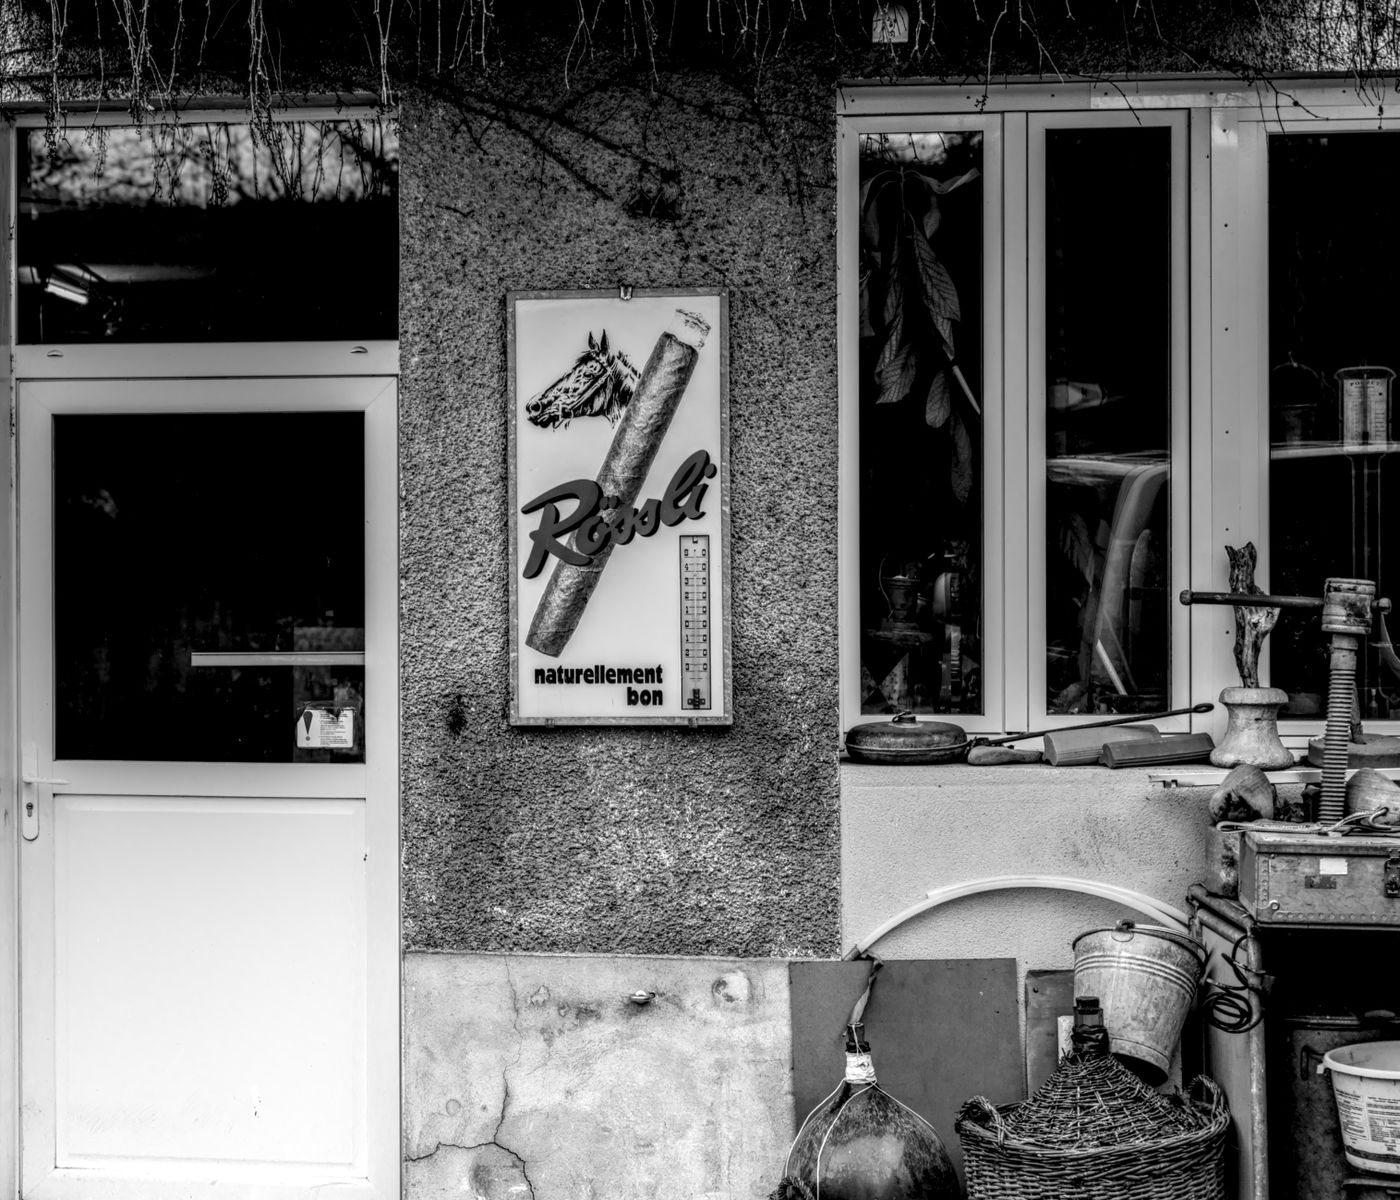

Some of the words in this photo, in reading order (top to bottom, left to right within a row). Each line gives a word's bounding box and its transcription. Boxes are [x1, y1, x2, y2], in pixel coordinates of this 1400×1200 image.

[521, 449, 717, 579] Rössli
[534, 664, 663, 684] naturellement
[627, 686, 663, 706] bon
